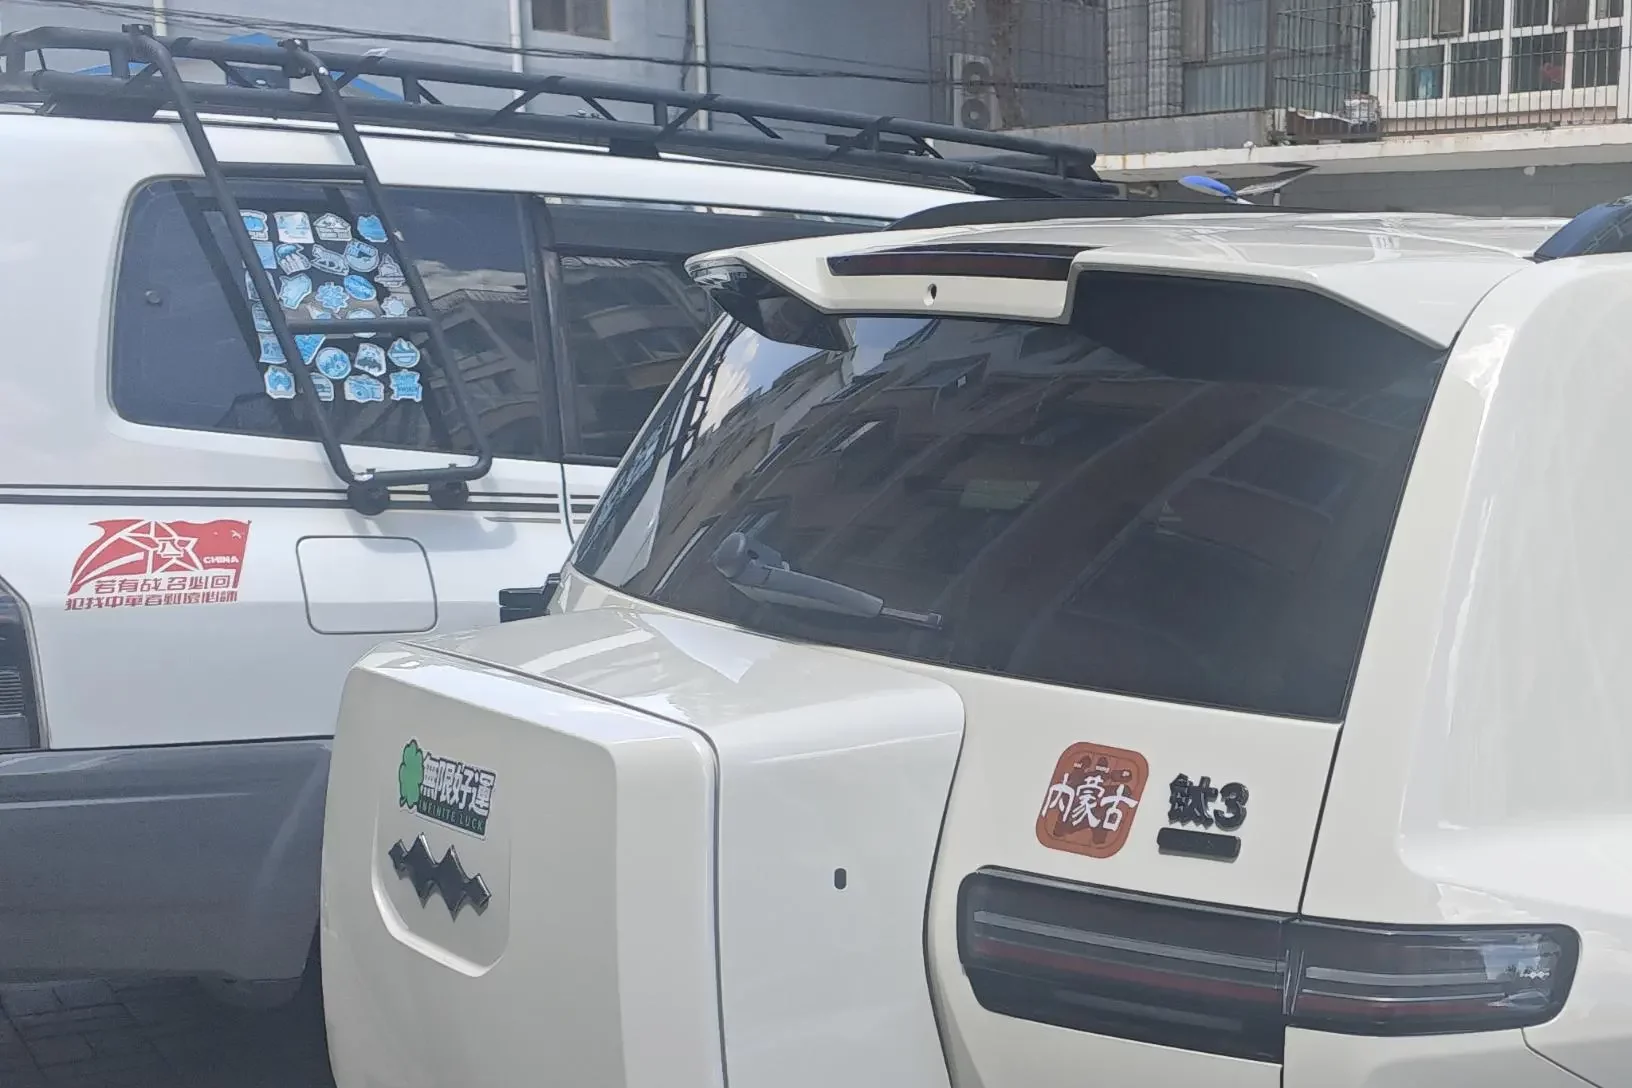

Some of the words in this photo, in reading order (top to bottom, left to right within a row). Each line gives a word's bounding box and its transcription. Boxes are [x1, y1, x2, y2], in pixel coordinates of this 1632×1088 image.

[203, 556, 240, 564] CHINA
[1041, 772, 1139, 832] 内蒙古
[1167, 773, 1249, 832] 钛3
